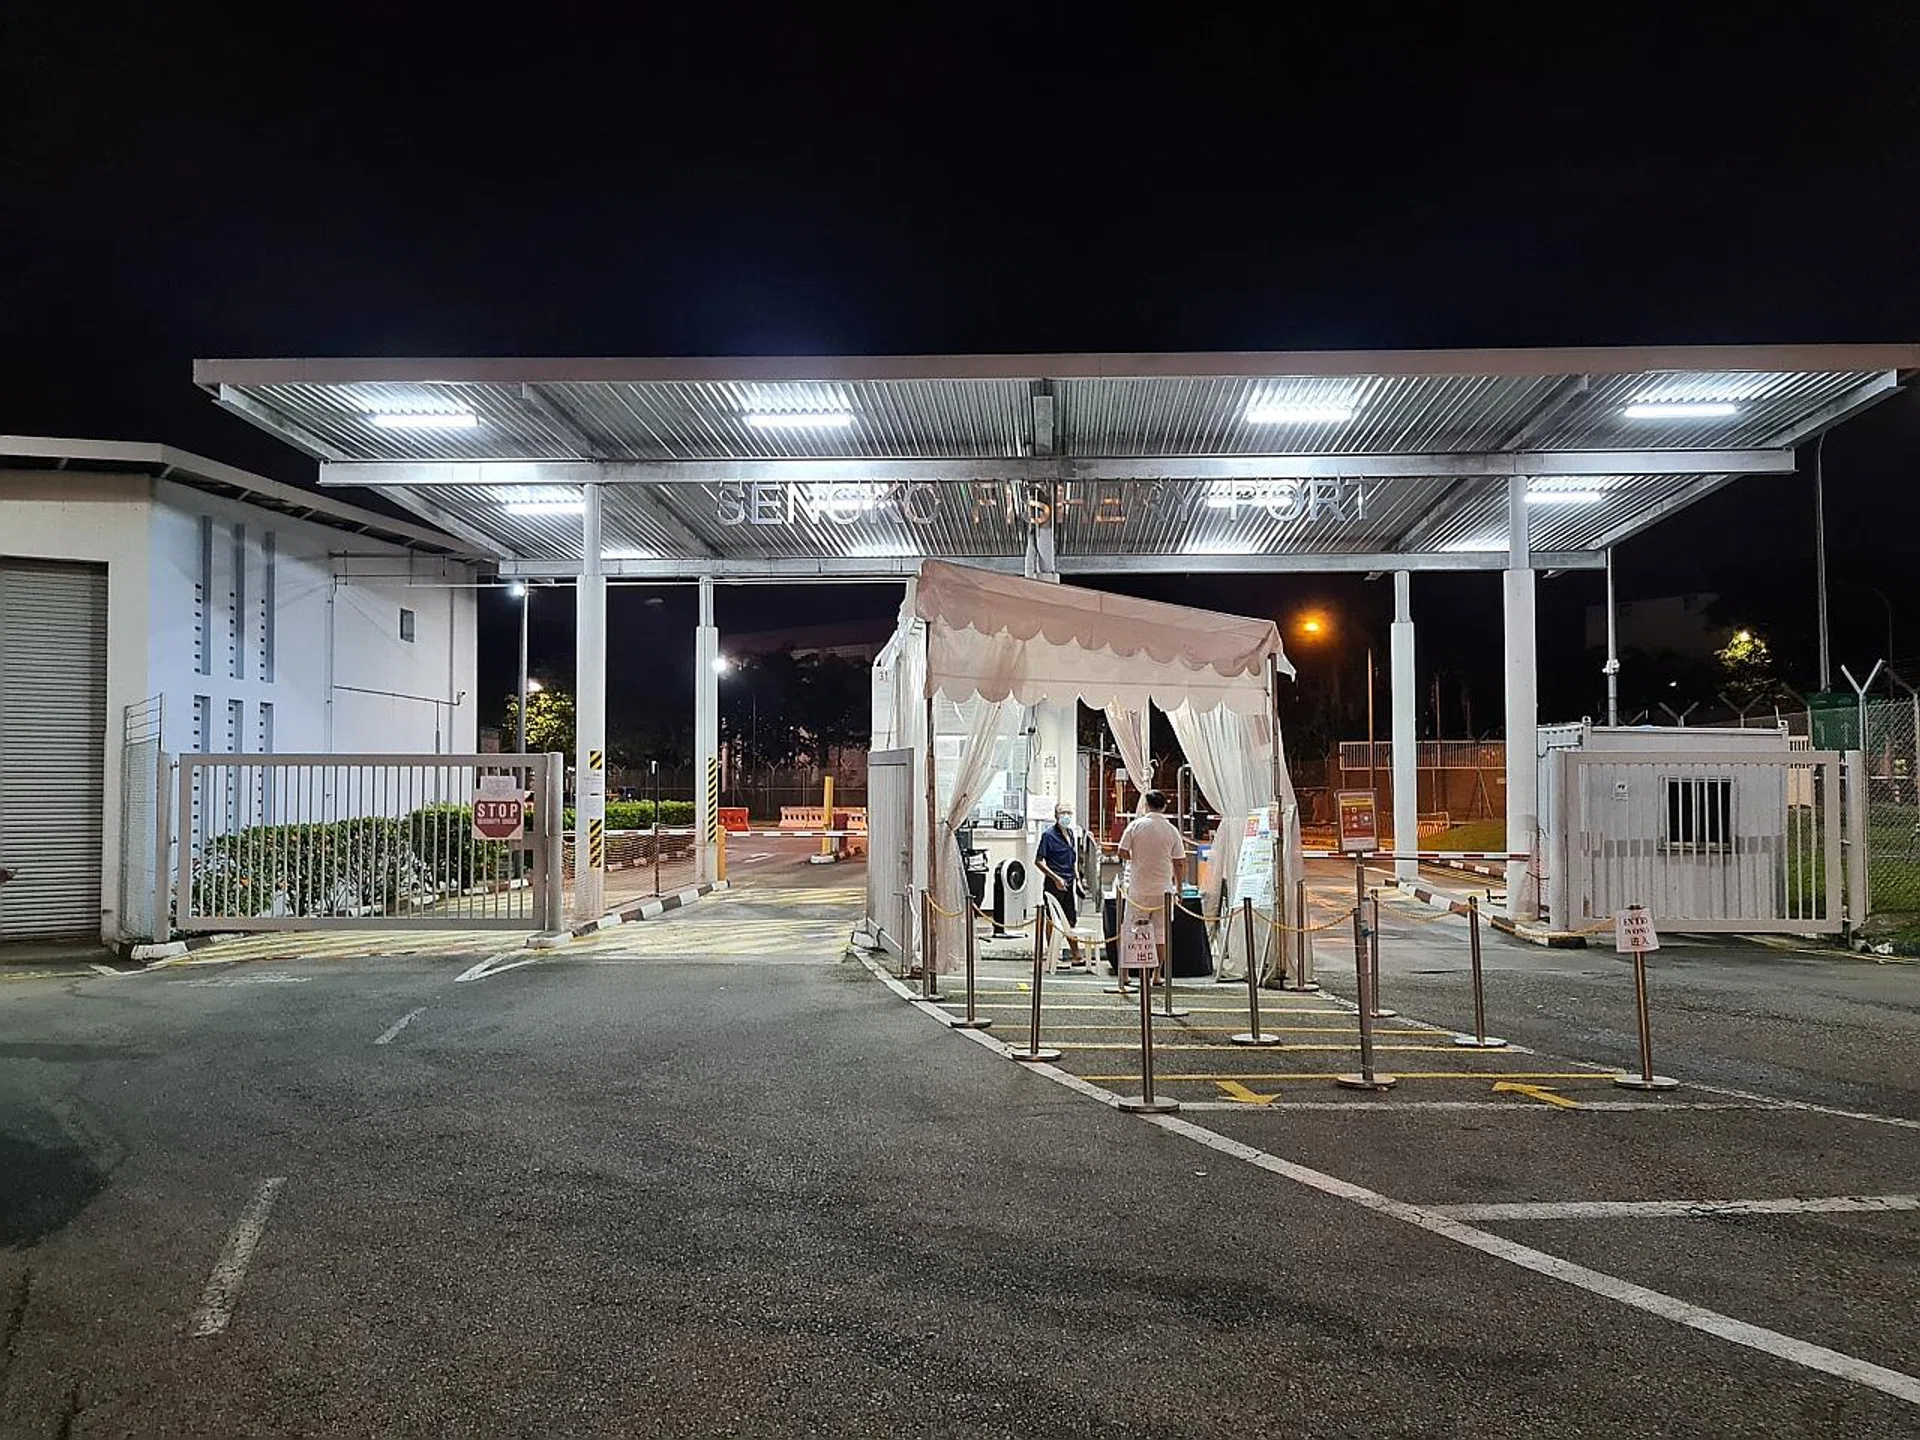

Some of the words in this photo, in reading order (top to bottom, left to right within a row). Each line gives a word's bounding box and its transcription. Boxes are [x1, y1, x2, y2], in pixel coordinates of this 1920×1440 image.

[717, 482, 943, 526] SENOKO
[971, 481, 1199, 526] FISHERY
[1226, 479, 1372, 524] PORT
[478, 803, 518, 818] STOP
